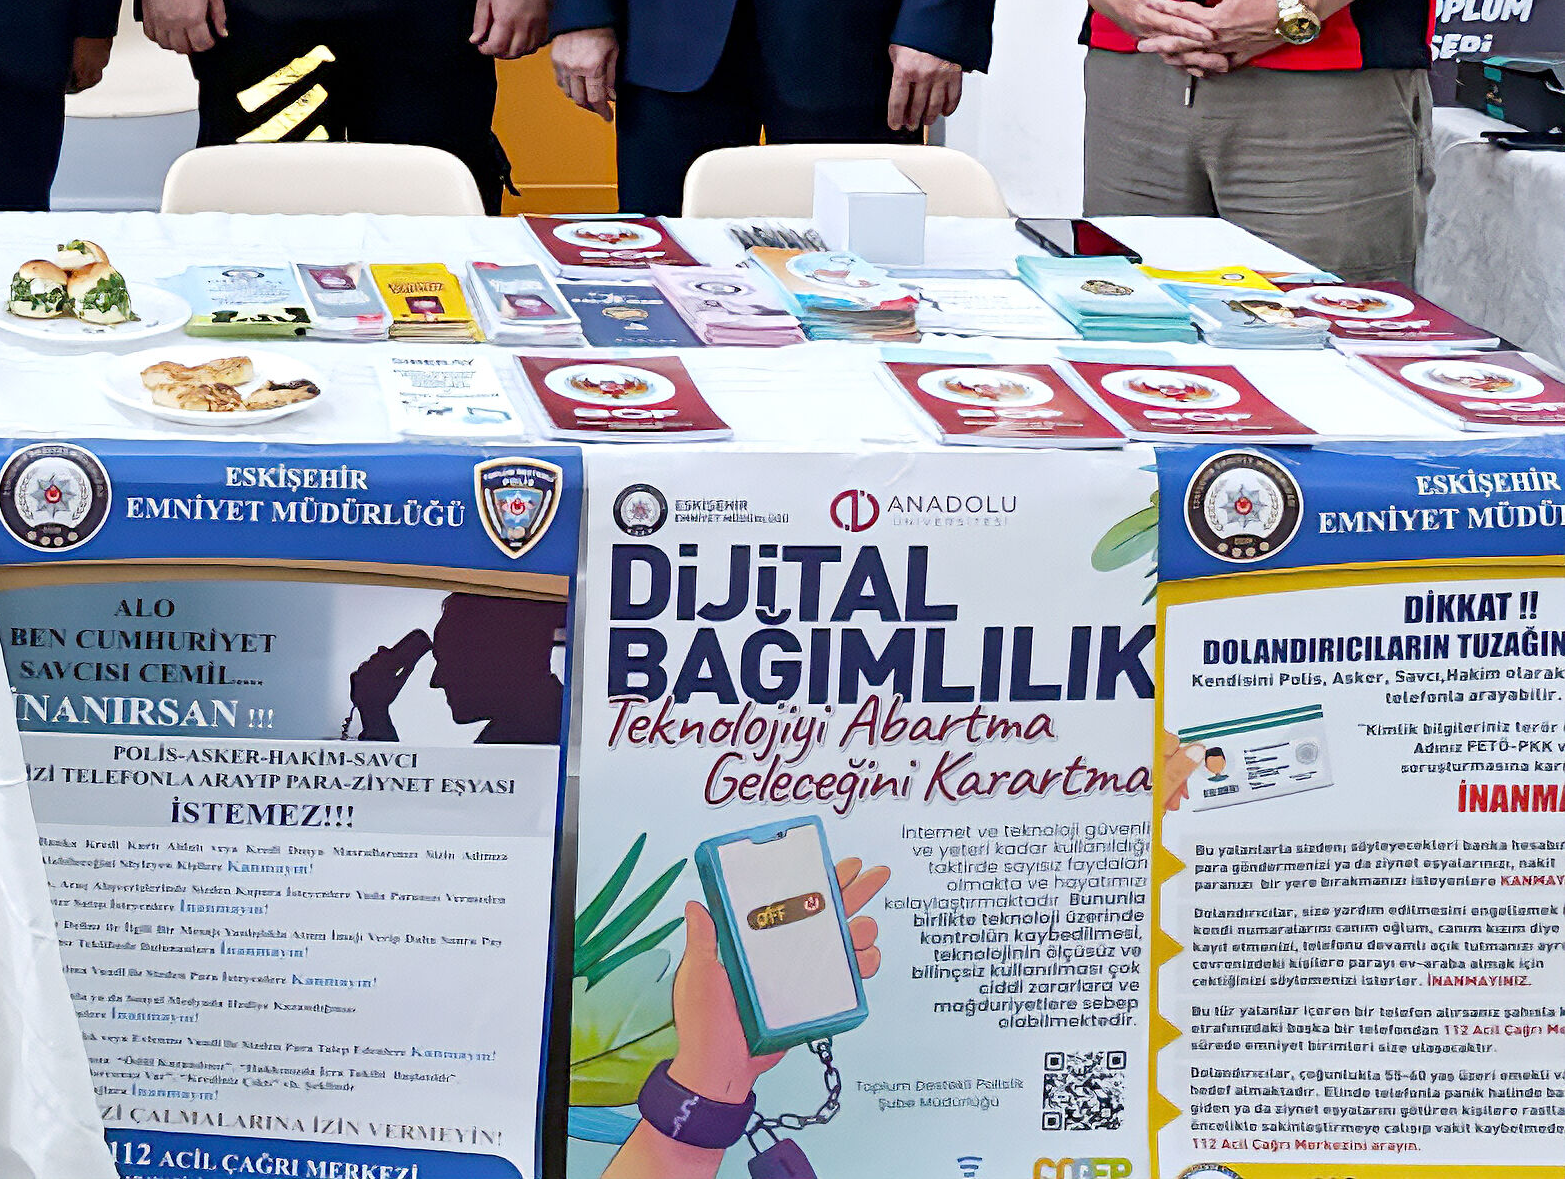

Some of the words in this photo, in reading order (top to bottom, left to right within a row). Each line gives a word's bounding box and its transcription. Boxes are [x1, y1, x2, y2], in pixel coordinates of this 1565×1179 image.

[226, 464, 368, 492] ESKİŞEHİR
[1416, 467, 1562, 498] ESKİŞEHİR
[126, 495, 263, 523] EMNİYET
[272, 498, 464, 528] MÜDÜRLÜĞÜ
[888, 495, 1016, 514] ANADOLU
[1319, 505, 1460, 533] EMNİYET
[114, 598, 175, 618] ALO
[1404, 590, 1511, 624] DİKKAT
[1519, 591, 1539, 619] !!
[11, 628, 66, 648] BEN
[76, 627, 275, 652] CUMHURİYET
[1203, 633, 1449, 664] DOLANDIRICILARIN
[608, 609, 1157, 705] BAĞIMLILIK
[20, 661, 129, 683] SAVCISI
[1192, 673, 1274, 687] Kendisini
[1385, 689, 1464, 704] telefonla
[1469, 687, 1562, 702] arayabilir.
[248, 708, 273, 729] !!!
[606, 695, 832, 762] Teknolojiyi
[840, 695, 1053, 747] Abartma
[1423, 722, 1510, 737] bilgileriniz
[1515, 721, 1556, 734] terör
[114, 743, 418, 769] POLİS-ASKER-HAKİM-SAVCI
[1414, 741, 1463, 754] Adınız
[1468, 739, 1552, 754] FETÖ-PKK
[1401, 760, 1530, 775] soruşturmasına
[61, 767, 193, 789] TELEFONLA
[201, 771, 279, 790] ARAYIP
[287, 771, 434, 794] PARA-ZİYNET
[441, 778, 515, 798] EŞYASI
[704, 752, 919, 815] Geleceğini
[924, 753, 1152, 805] Karartma
[171, 796, 355, 828] İSTEMEZ!!!
[978, 827, 997, 838] ve
[1004, 824, 1079, 840] teknoloji
[913, 845, 933, 857] ve
[940, 842, 989, 859] yeteri
[995, 841, 1047, 854] kadar
[227, 860, 312, 876] Kanmayın!
[947, 878, 1022, 891] olmakta
[1028, 877, 1048, 889] ve
[180, 899, 268, 916] İnanmayın!
[1069, 893, 1145, 905] Bununla
[914, 913, 976, 927] birlikte
[983, 912, 1059, 928] teknoloji
[1066, 909, 1144, 922] üzerinde
[921, 930, 1008, 944] kontrolün
[220, 940, 309, 959] İnanmayın!
[934, 947, 1040, 963] teknolojinin
[1046, 945, 1116, 961] ölçüsüz
[1122, 945, 1141, 957] ve
[292, 973, 376, 989] Kanmayın!
[912, 965, 984, 981] bilinçsiz
[990, 963, 1103, 978] kullanılması
[1109, 962, 1140, 976] çok
[1028, 980, 1112, 994] zararlara
[1118, 980, 1139, 992] ve
[111, 1007, 199, 1024] İnanmayın!
[934, 999, 1077, 1016] mağduriyetlere
[1083, 997, 1138, 1013] sebep
[999, 1014, 1137, 1029] olabilmektedir.
[1444, 1024, 1468, 1035] 112
[1473, 1024, 1499, 1035] Acil
[1505, 1023, 1543, 1038] Çağrı
[411, 1046, 496, 1062] Kanmayın!
[131, 1084, 218, 1102] İnanmayın!
[856, 1080, 910, 1094] Toplum
[130, 1105, 304, 1133] ÇALMALARINA
[314, 1115, 359, 1137] İZİN
[370, 1121, 503, 1146] VERMEYİN!
[1193, 1138, 1216, 1150] 112
[1221, 1138, 1248, 1150] Acil
[1253, 1138, 1290, 1153] Çağrı
[1295, 1138, 1366, 1152] Merkezini
[159, 1147, 215, 1170] ACİL
[221, 1148, 297, 1176] ÇAĞRI
[307, 1158, 418, 1179] MERKEZİ
